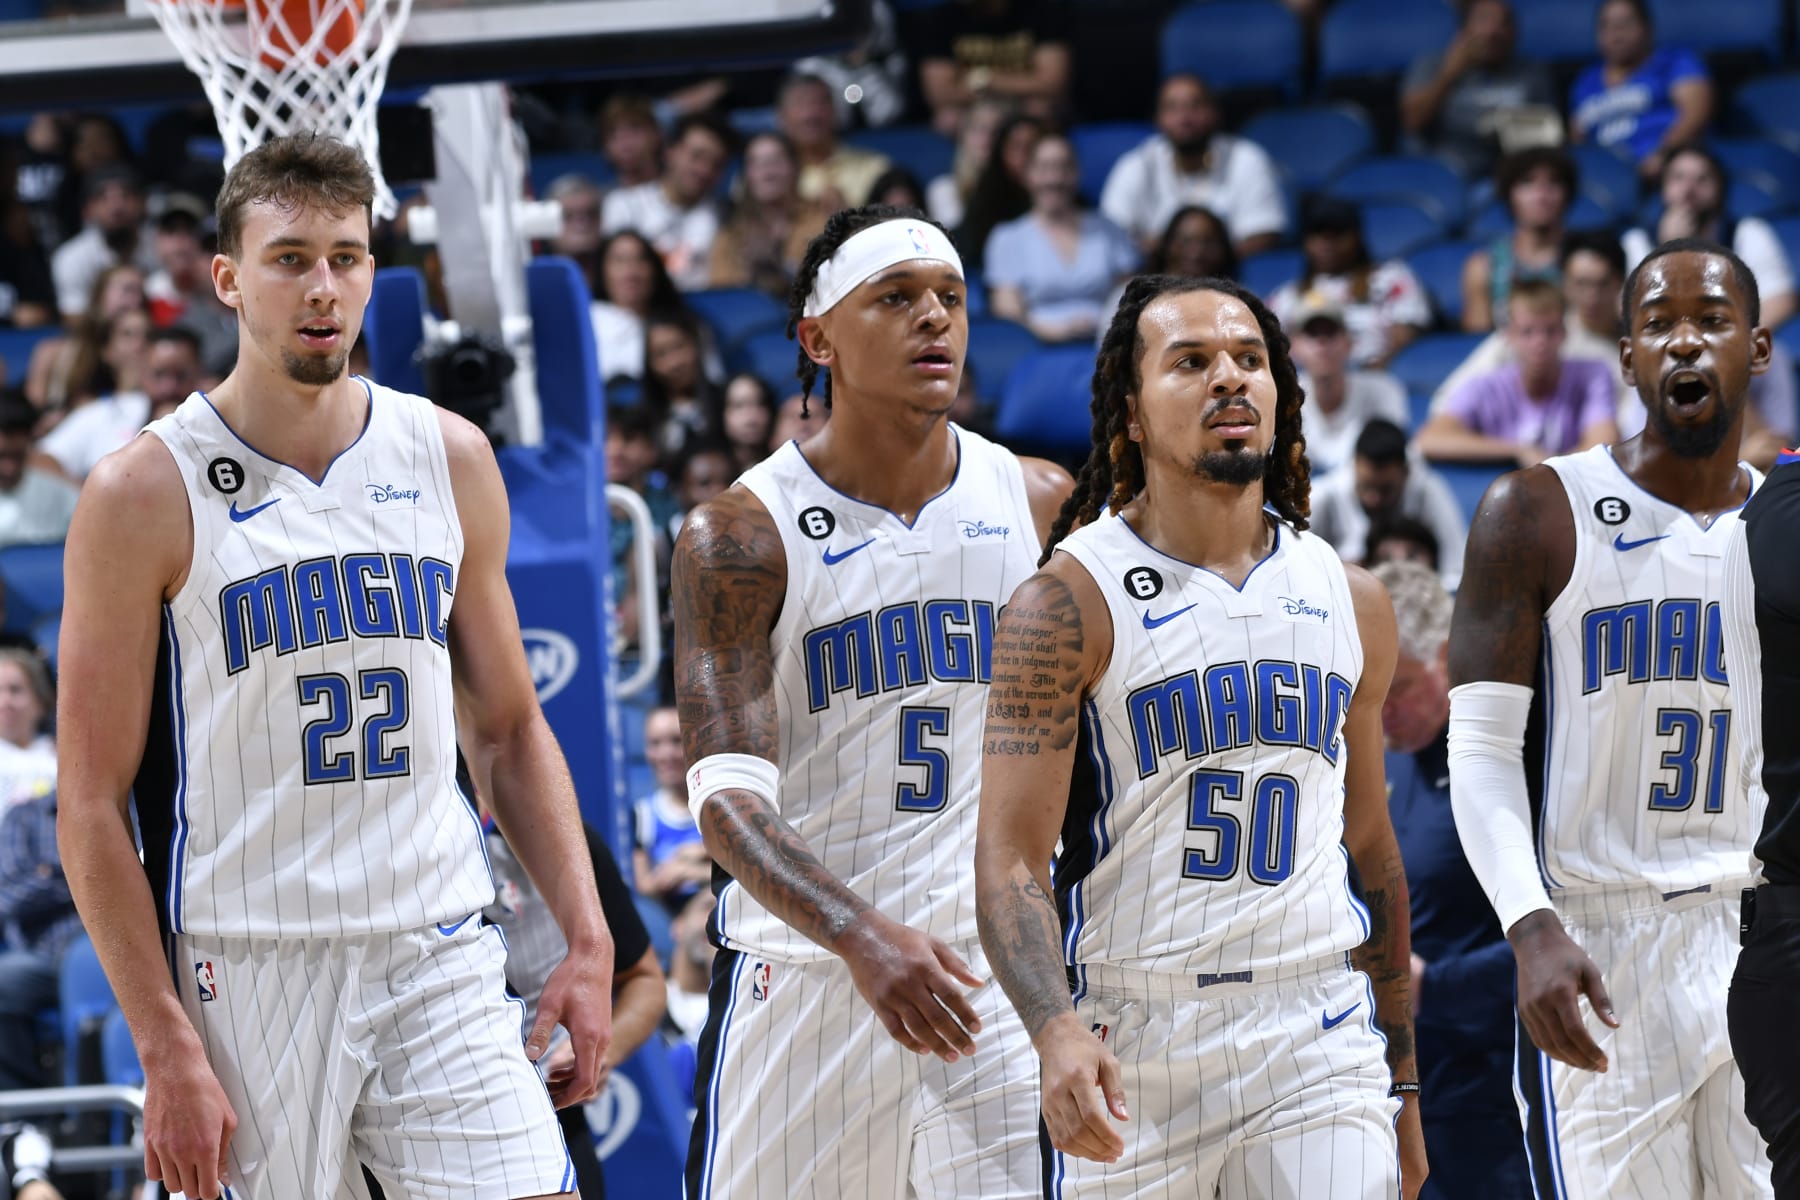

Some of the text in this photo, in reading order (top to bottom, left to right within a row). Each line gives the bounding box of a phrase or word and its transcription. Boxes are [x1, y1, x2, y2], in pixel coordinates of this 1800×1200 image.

[215, 463, 237, 490] 6
[1601, 499, 1623, 522] 6
[805, 511, 830, 537] 6
[1131, 571, 1157, 597] 6
[219, 553, 454, 677] MAGIC
[803, 599, 1006, 714] MAGI
[1019, 639, 1034, 652] that
[1036, 641, 1057, 654] shall
[1012, 656, 1020, 665] in
[1020, 655, 1060, 670] judgment
[1012, 687, 1023, 699] the
[1025, 689, 1061, 700] servants
[1029, 673, 1056, 688] This
[1037, 706, 1053, 719] and
[1126, 659, 1352, 780] MAGIC
[297, 667, 410, 785] 22
[1017, 723, 1026, 735] is
[1027, 724, 1037, 736] of
[896, 706, 950, 813] 5
[1648, 708, 1732, 813] 31
[1182, 767, 1299, 886] 50
